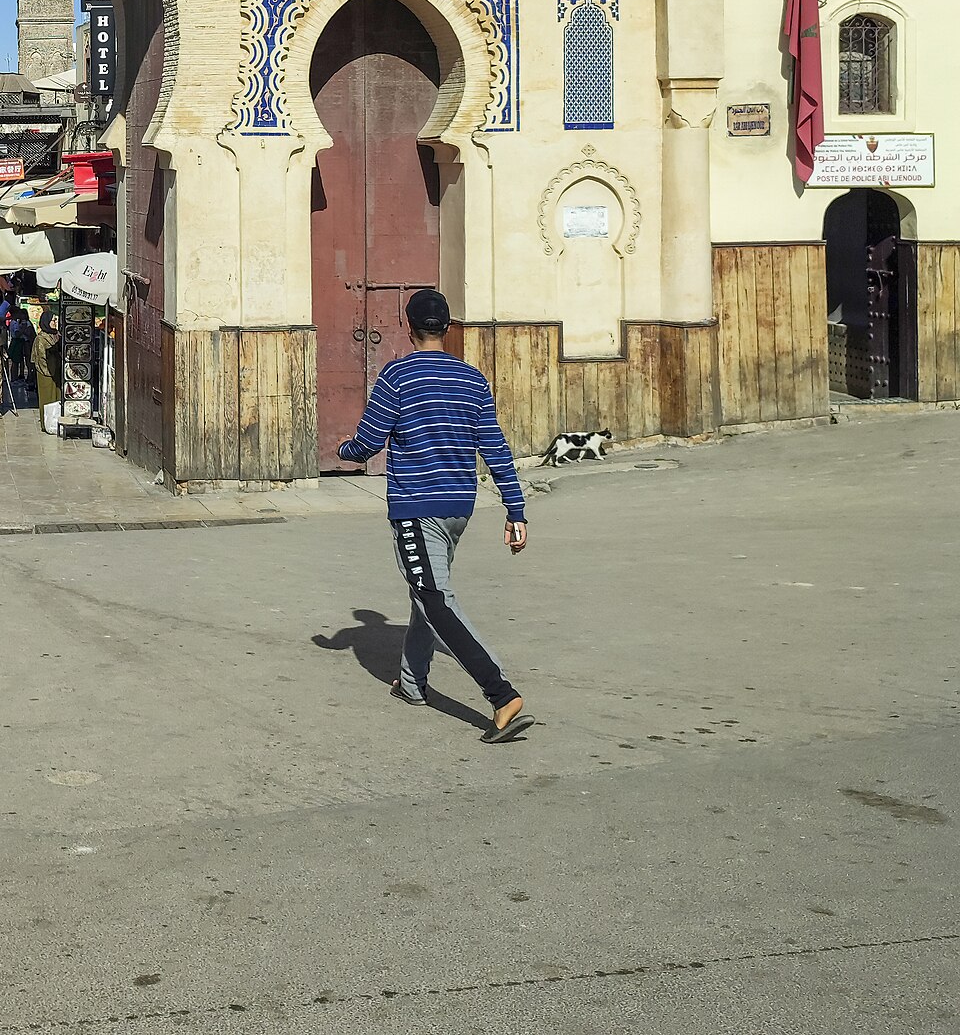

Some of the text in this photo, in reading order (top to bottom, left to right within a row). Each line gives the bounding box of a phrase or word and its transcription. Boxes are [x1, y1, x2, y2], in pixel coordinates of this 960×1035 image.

[97, 15, 109, 91] HOTEL
[865, 153, 900, 163] الشرطة
[903, 153, 927, 163] مركز
[401, 520, 424, 575] ORDAN
